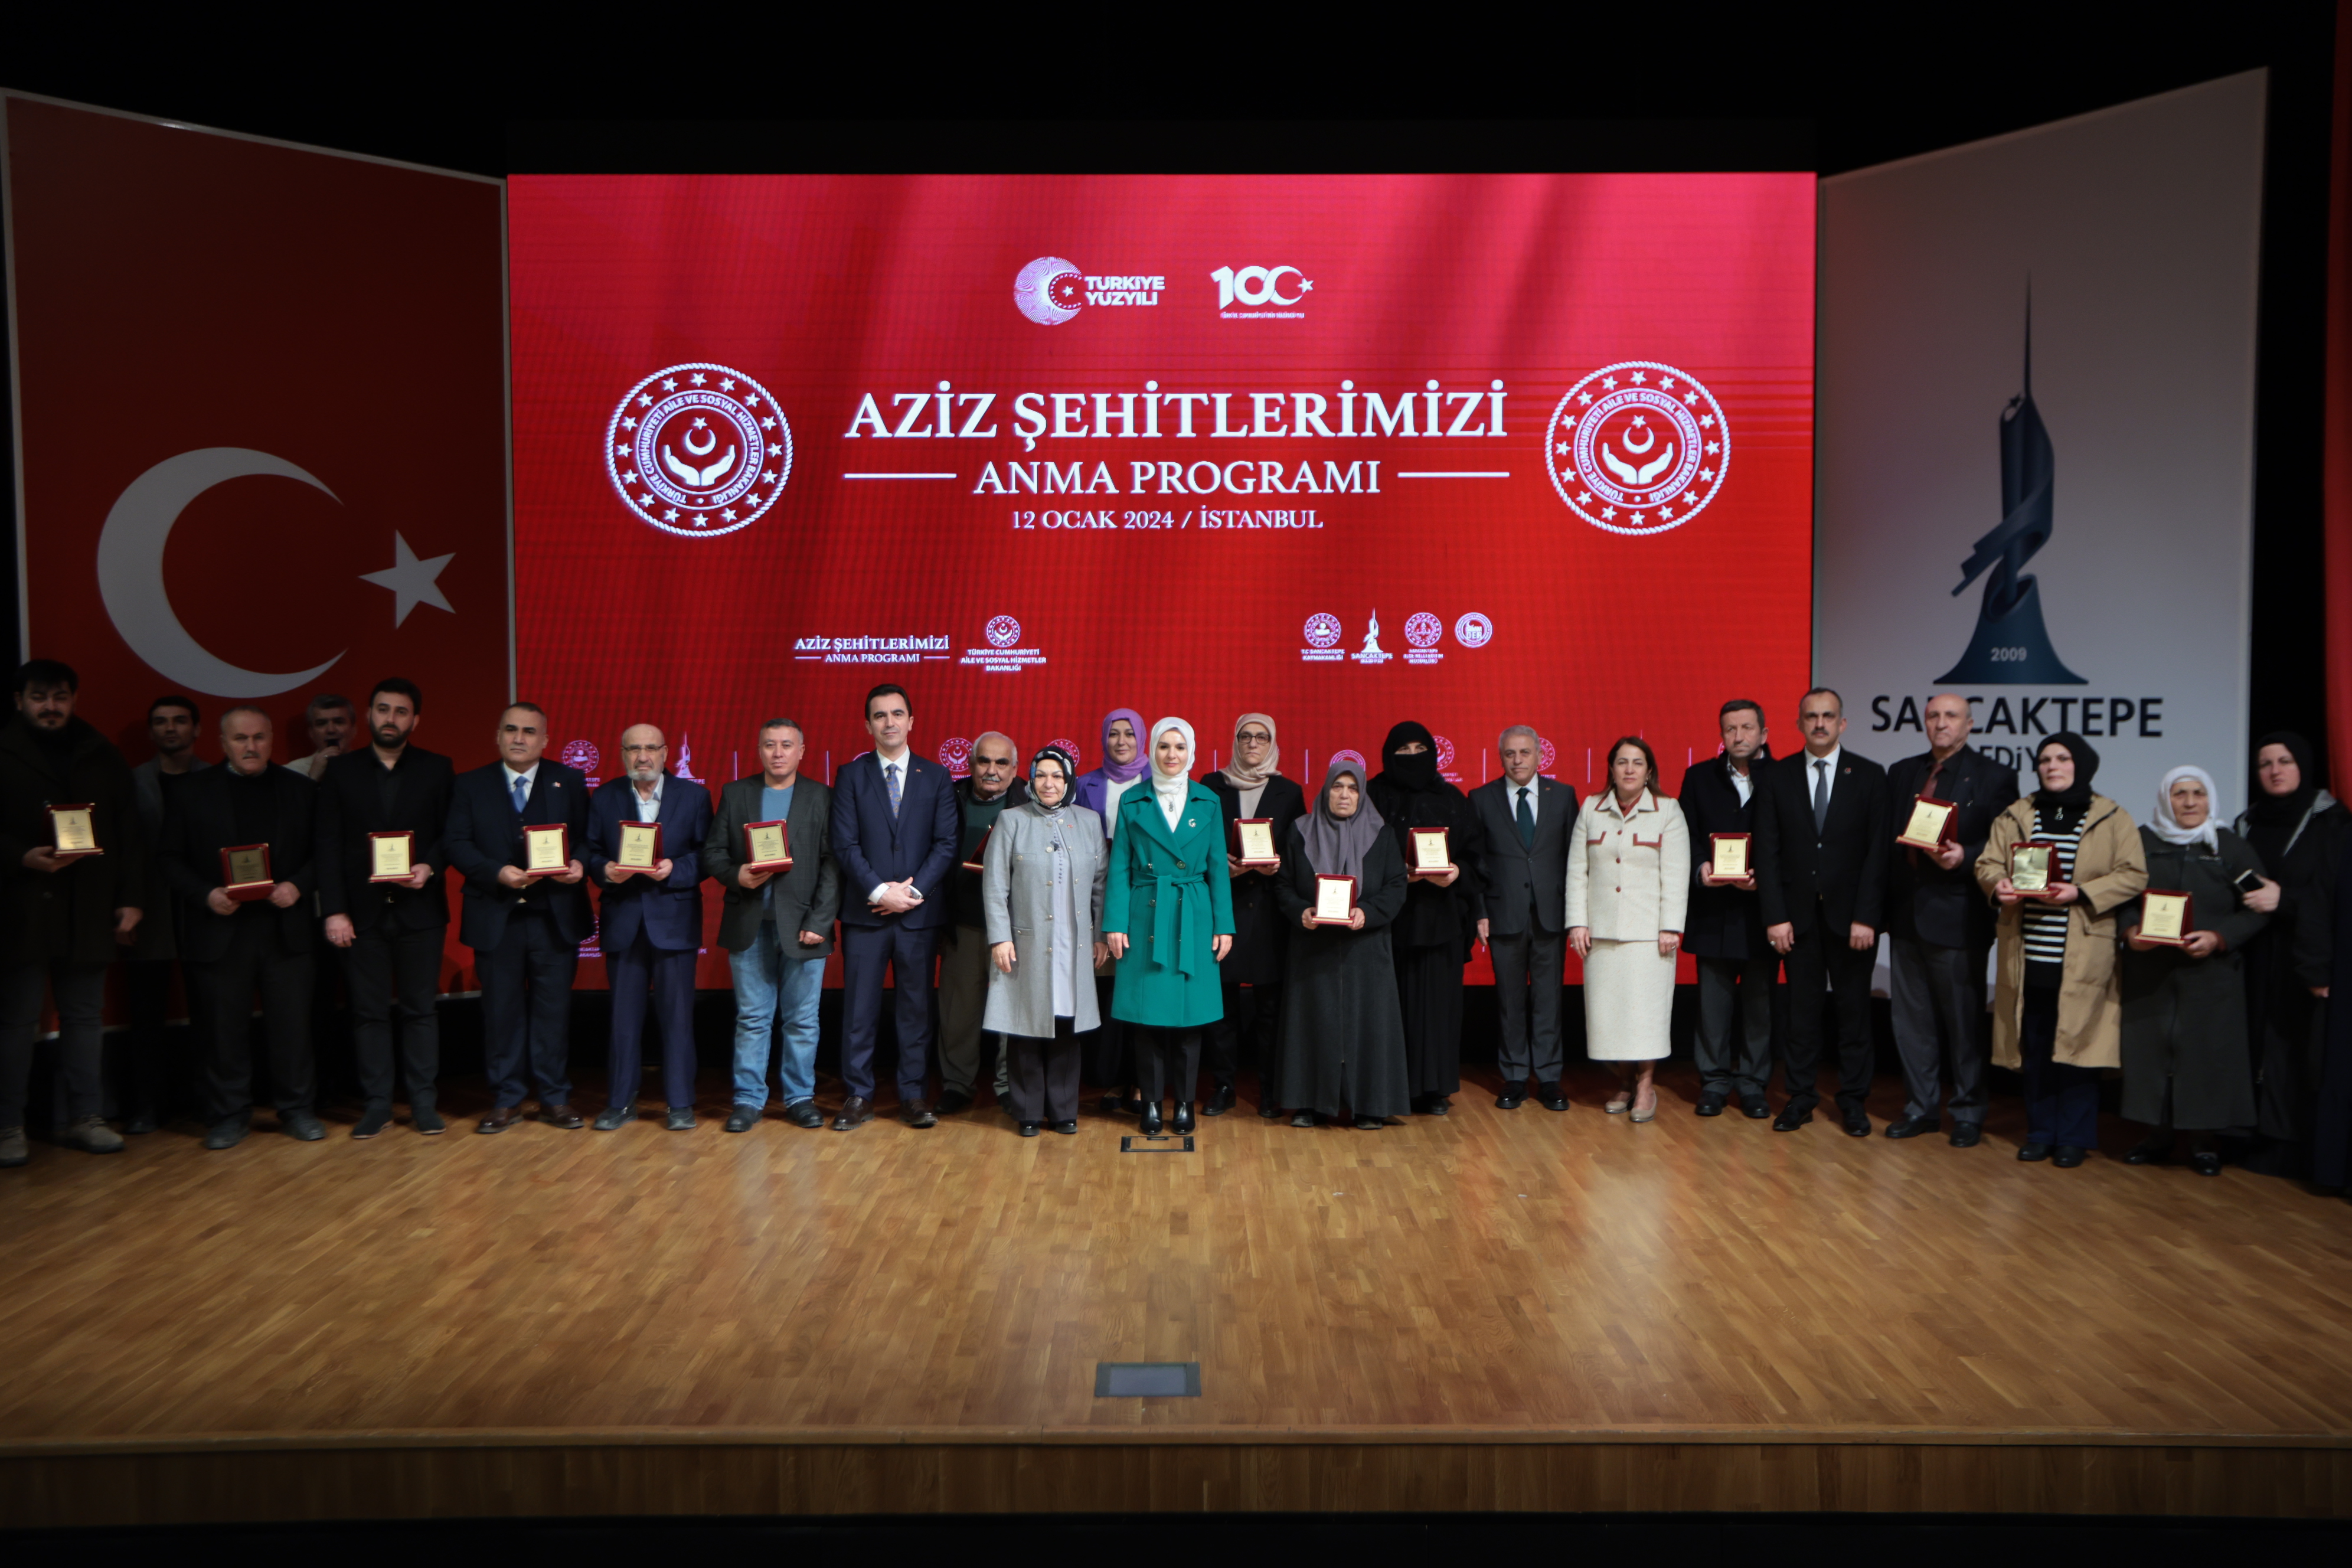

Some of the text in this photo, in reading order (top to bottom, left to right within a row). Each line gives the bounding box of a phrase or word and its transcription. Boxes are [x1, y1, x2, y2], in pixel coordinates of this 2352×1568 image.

[844, 380, 1508, 452] AZİZ ŞEHİTLERİMİZİ
[641, 394, 760, 504] TÜRKİYE CUMHURİYETİ AİLE VE SOSYAL HİZMETLER BAKANLIĞI
[1579, 393, 1698, 502] TÜRKİYE CUMHURİYETİ AİLE VE SOSYAL HİZMETLER BAKANLIĞI
[973, 460, 1381, 495] ANMA PROGRAMI
[1014, 511, 1035, 530] 12
[1041, 510, 1118, 529] OCAK
[1124, 511, 1175, 530] 2024
[1200, 505, 1324, 529] İSTANBUL
[794, 635, 949, 652] AZİZ ŞEHİTLERİMİZİ
[825, 654, 920, 663] ANMA PROGRAMI
[1991, 647, 2027, 662] 2009
[1871, 695, 2163, 737] SACAKTEPE
